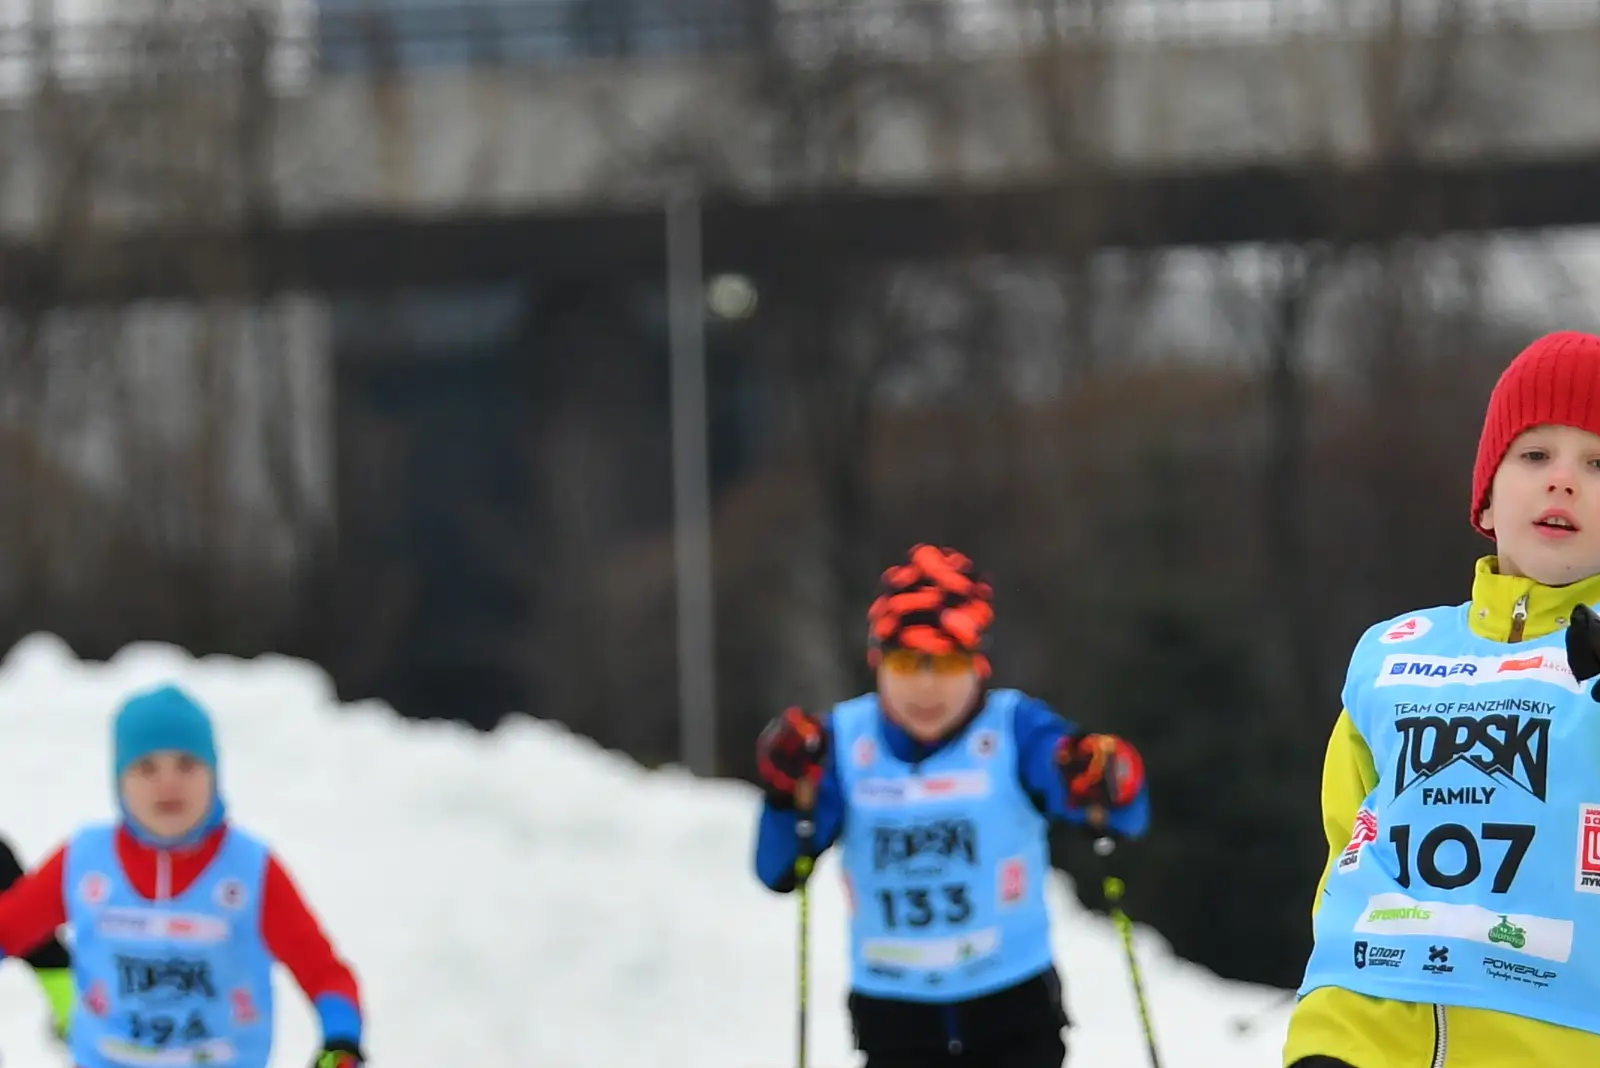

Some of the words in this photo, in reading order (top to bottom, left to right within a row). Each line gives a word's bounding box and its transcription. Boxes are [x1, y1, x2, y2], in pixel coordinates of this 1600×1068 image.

[1407, 662, 1478, 678] MAER
[1394, 702, 1432, 716] TEAM
[1435, 702, 1455, 714] OF
[1457, 698, 1556, 716] PANZHINSKIY
[1394, 714, 1552, 803] TOPSKI
[1422, 786, 1497, 805] FAMILY
[1389, 822, 1536, 894] 107
[877, 882, 971, 931] 133
[1369, 946, 1406, 960] СПОРТ
[1482, 956, 1557, 979] POWERUP
